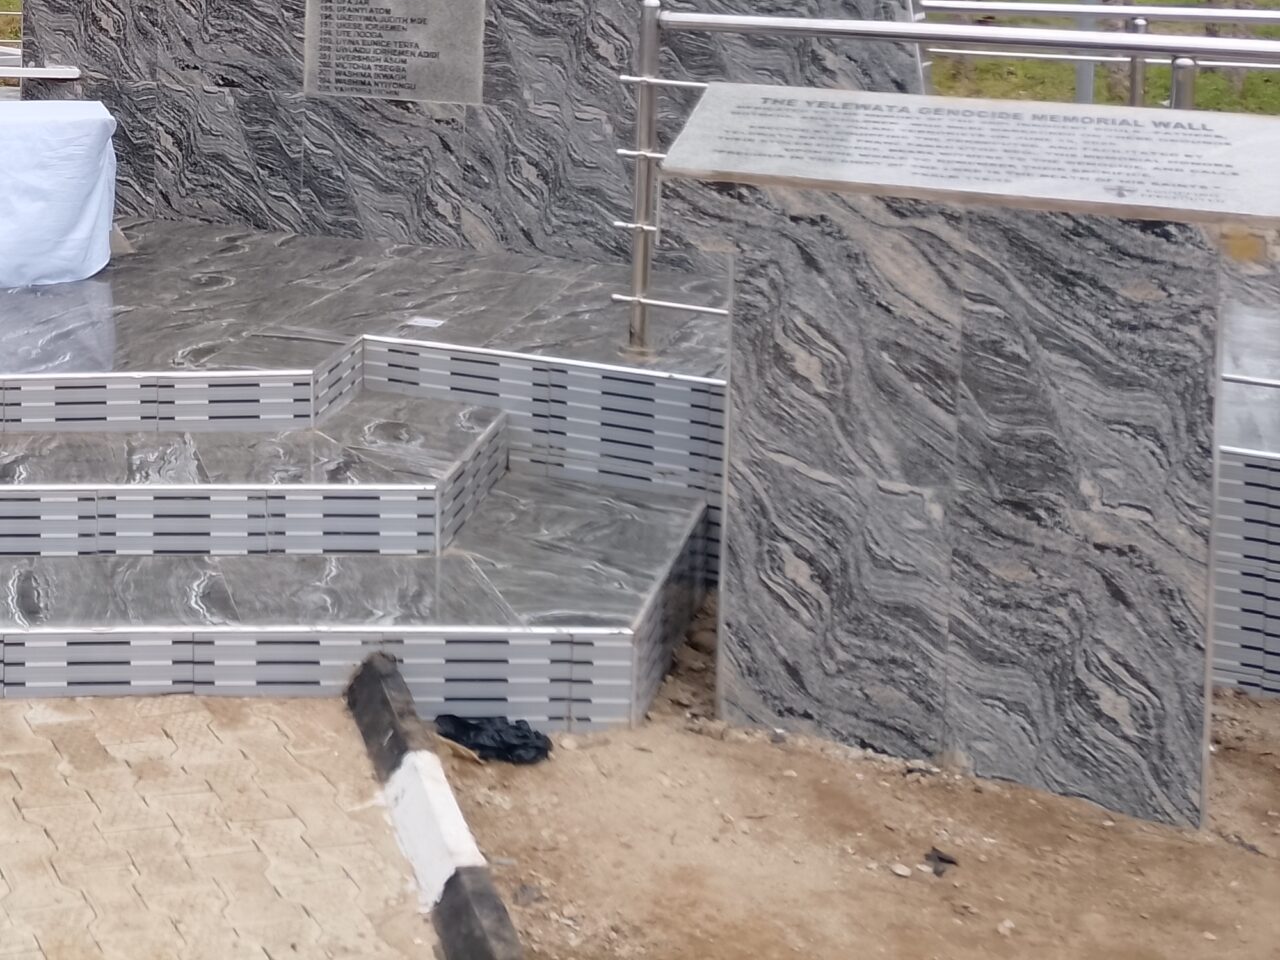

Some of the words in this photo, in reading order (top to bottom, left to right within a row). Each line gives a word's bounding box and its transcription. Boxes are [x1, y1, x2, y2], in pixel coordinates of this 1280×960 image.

[758, 97, 798, 106] THE
[803, 100, 911, 113] YELEWATA
[916, 106, 1023, 120] GENOCIDE
[1030, 113, 1144, 127] MEMORIAL
[1151, 120, 1215, 131] WALL
